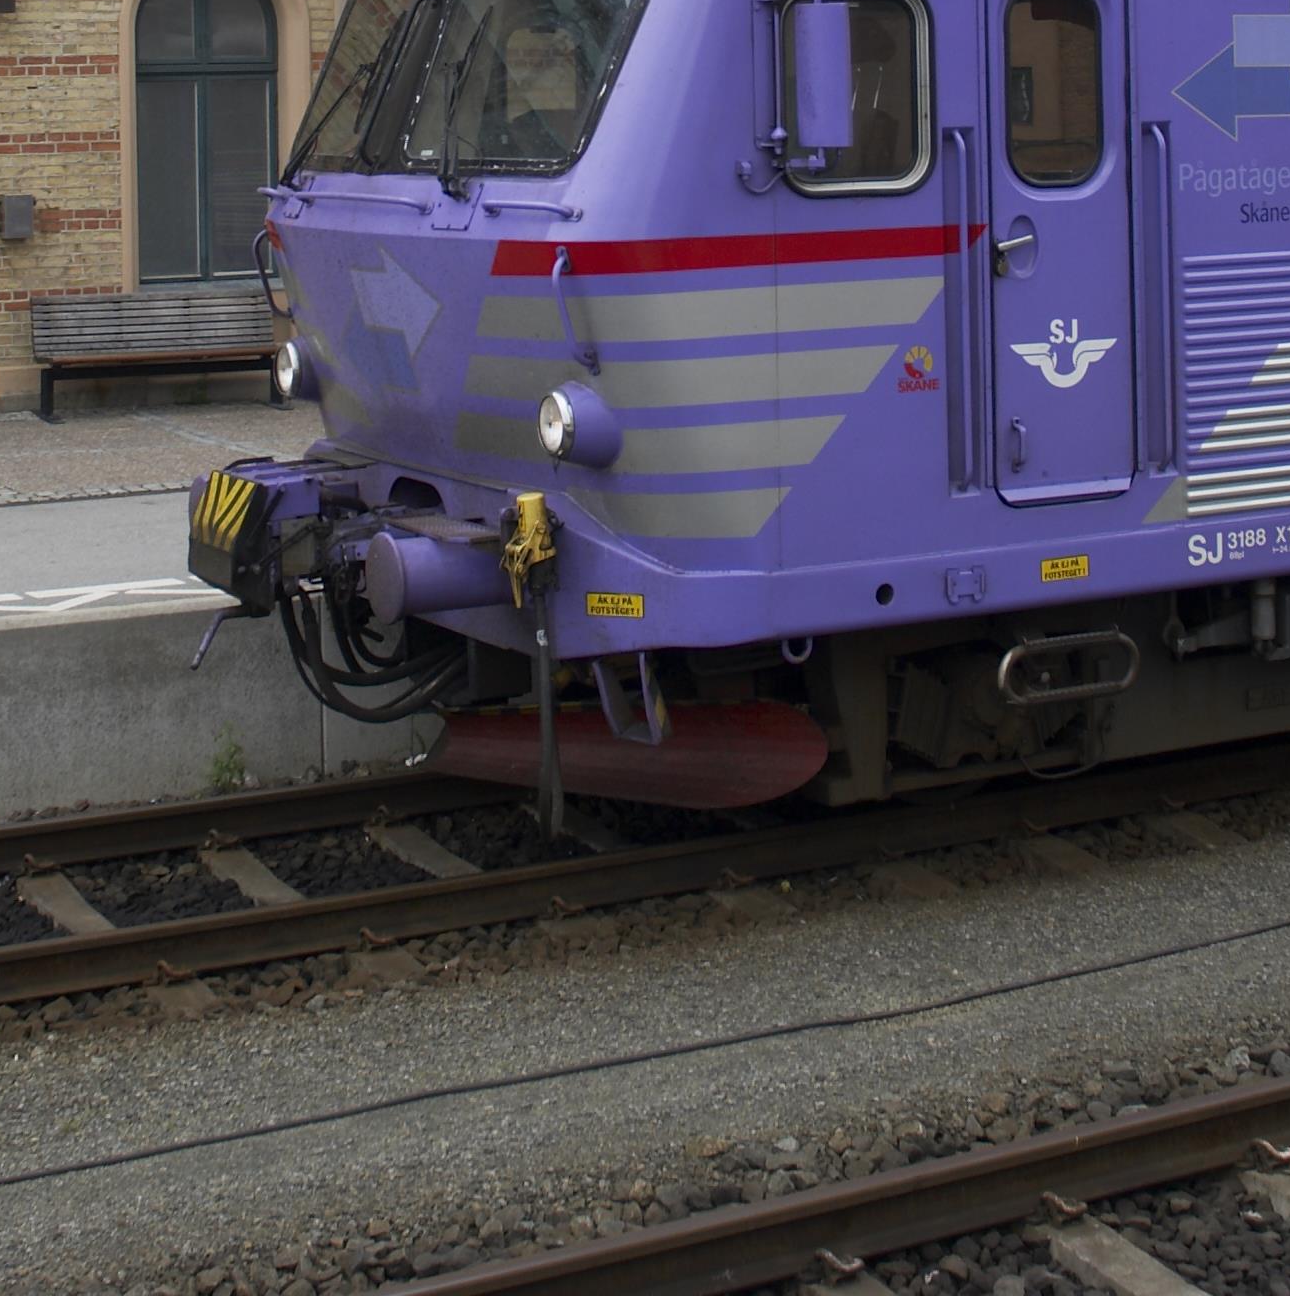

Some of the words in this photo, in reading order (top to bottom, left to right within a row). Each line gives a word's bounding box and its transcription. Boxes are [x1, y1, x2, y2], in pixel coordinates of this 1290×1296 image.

[1049, 318, 1078, 344] SJ
[1188, 532, 1223, 566] SJ
[1228, 528, 1267, 549] 3188
